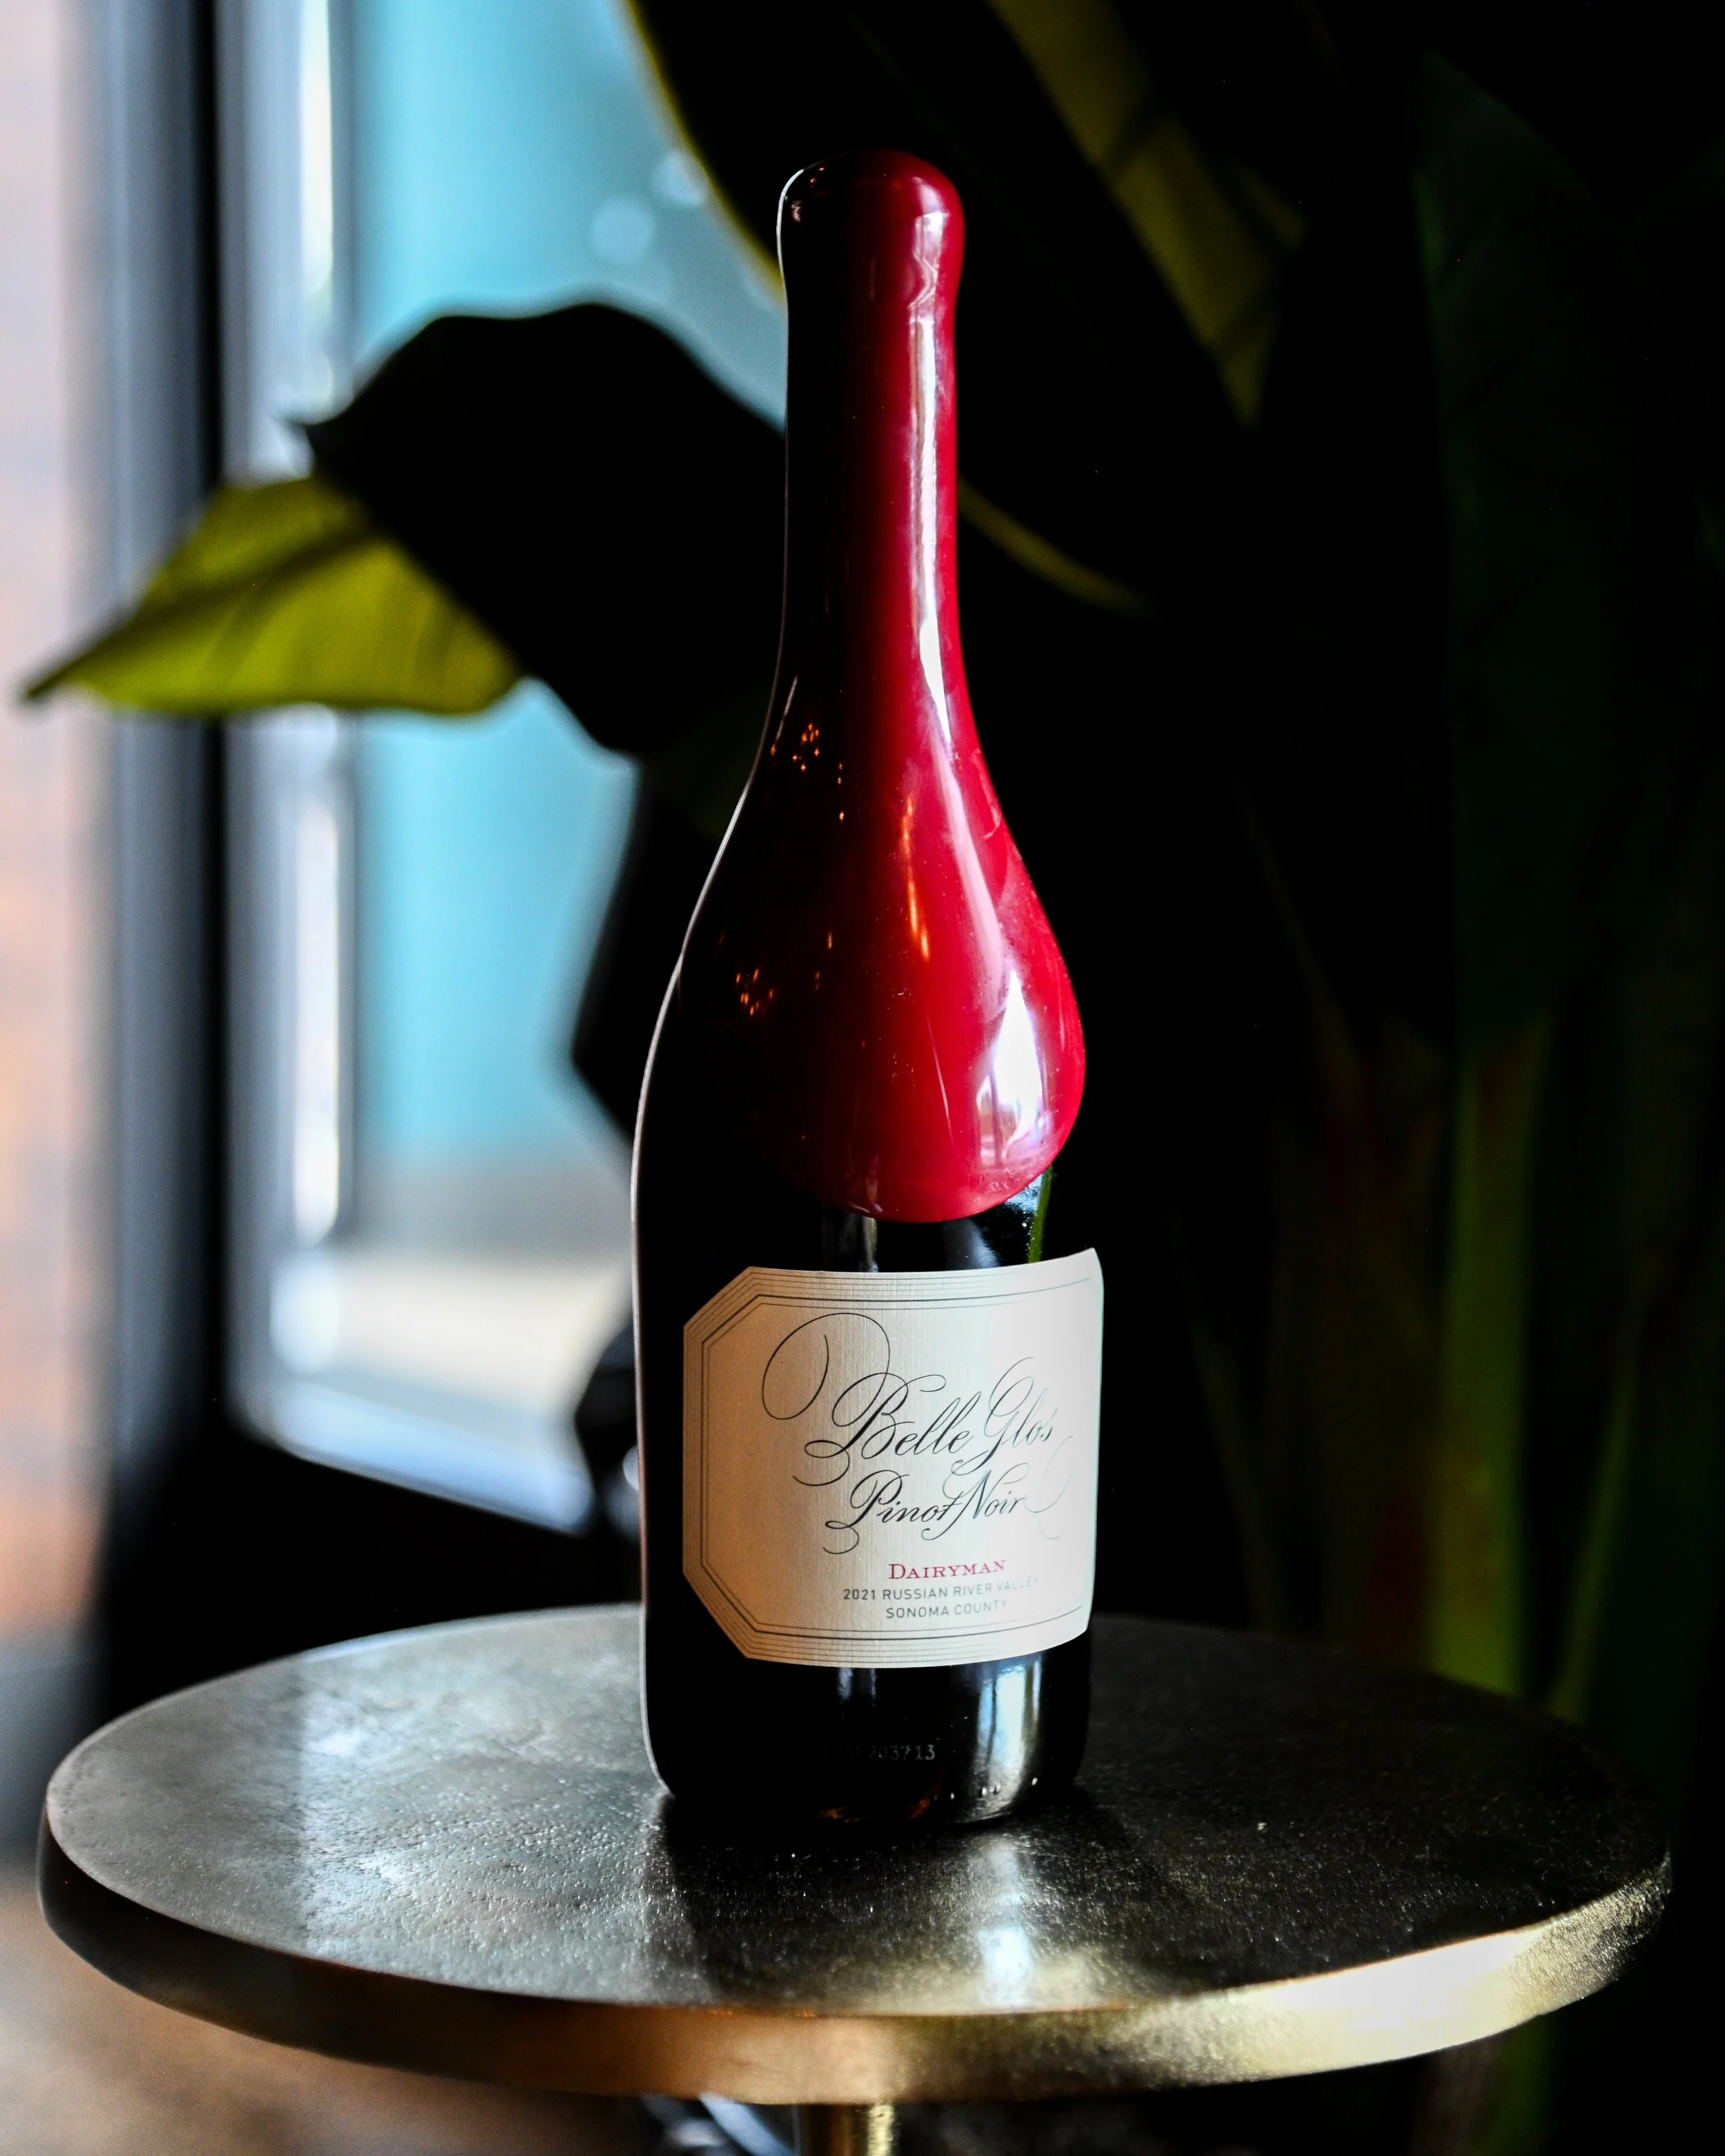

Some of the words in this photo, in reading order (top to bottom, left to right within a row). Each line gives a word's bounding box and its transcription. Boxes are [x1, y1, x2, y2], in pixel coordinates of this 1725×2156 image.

[951, 1356, 1059, 1476] Glos
[822, 1470, 964, 1554] Pinot
[842, 1588, 876, 1601] 2021
[882, 1587, 948, 1601] RUSSIAN
[952, 1583, 993, 1598] RIVER
[885, 1604, 949, 1619] SONOMA
[954, 1599, 1008, 1616] COUNTY
